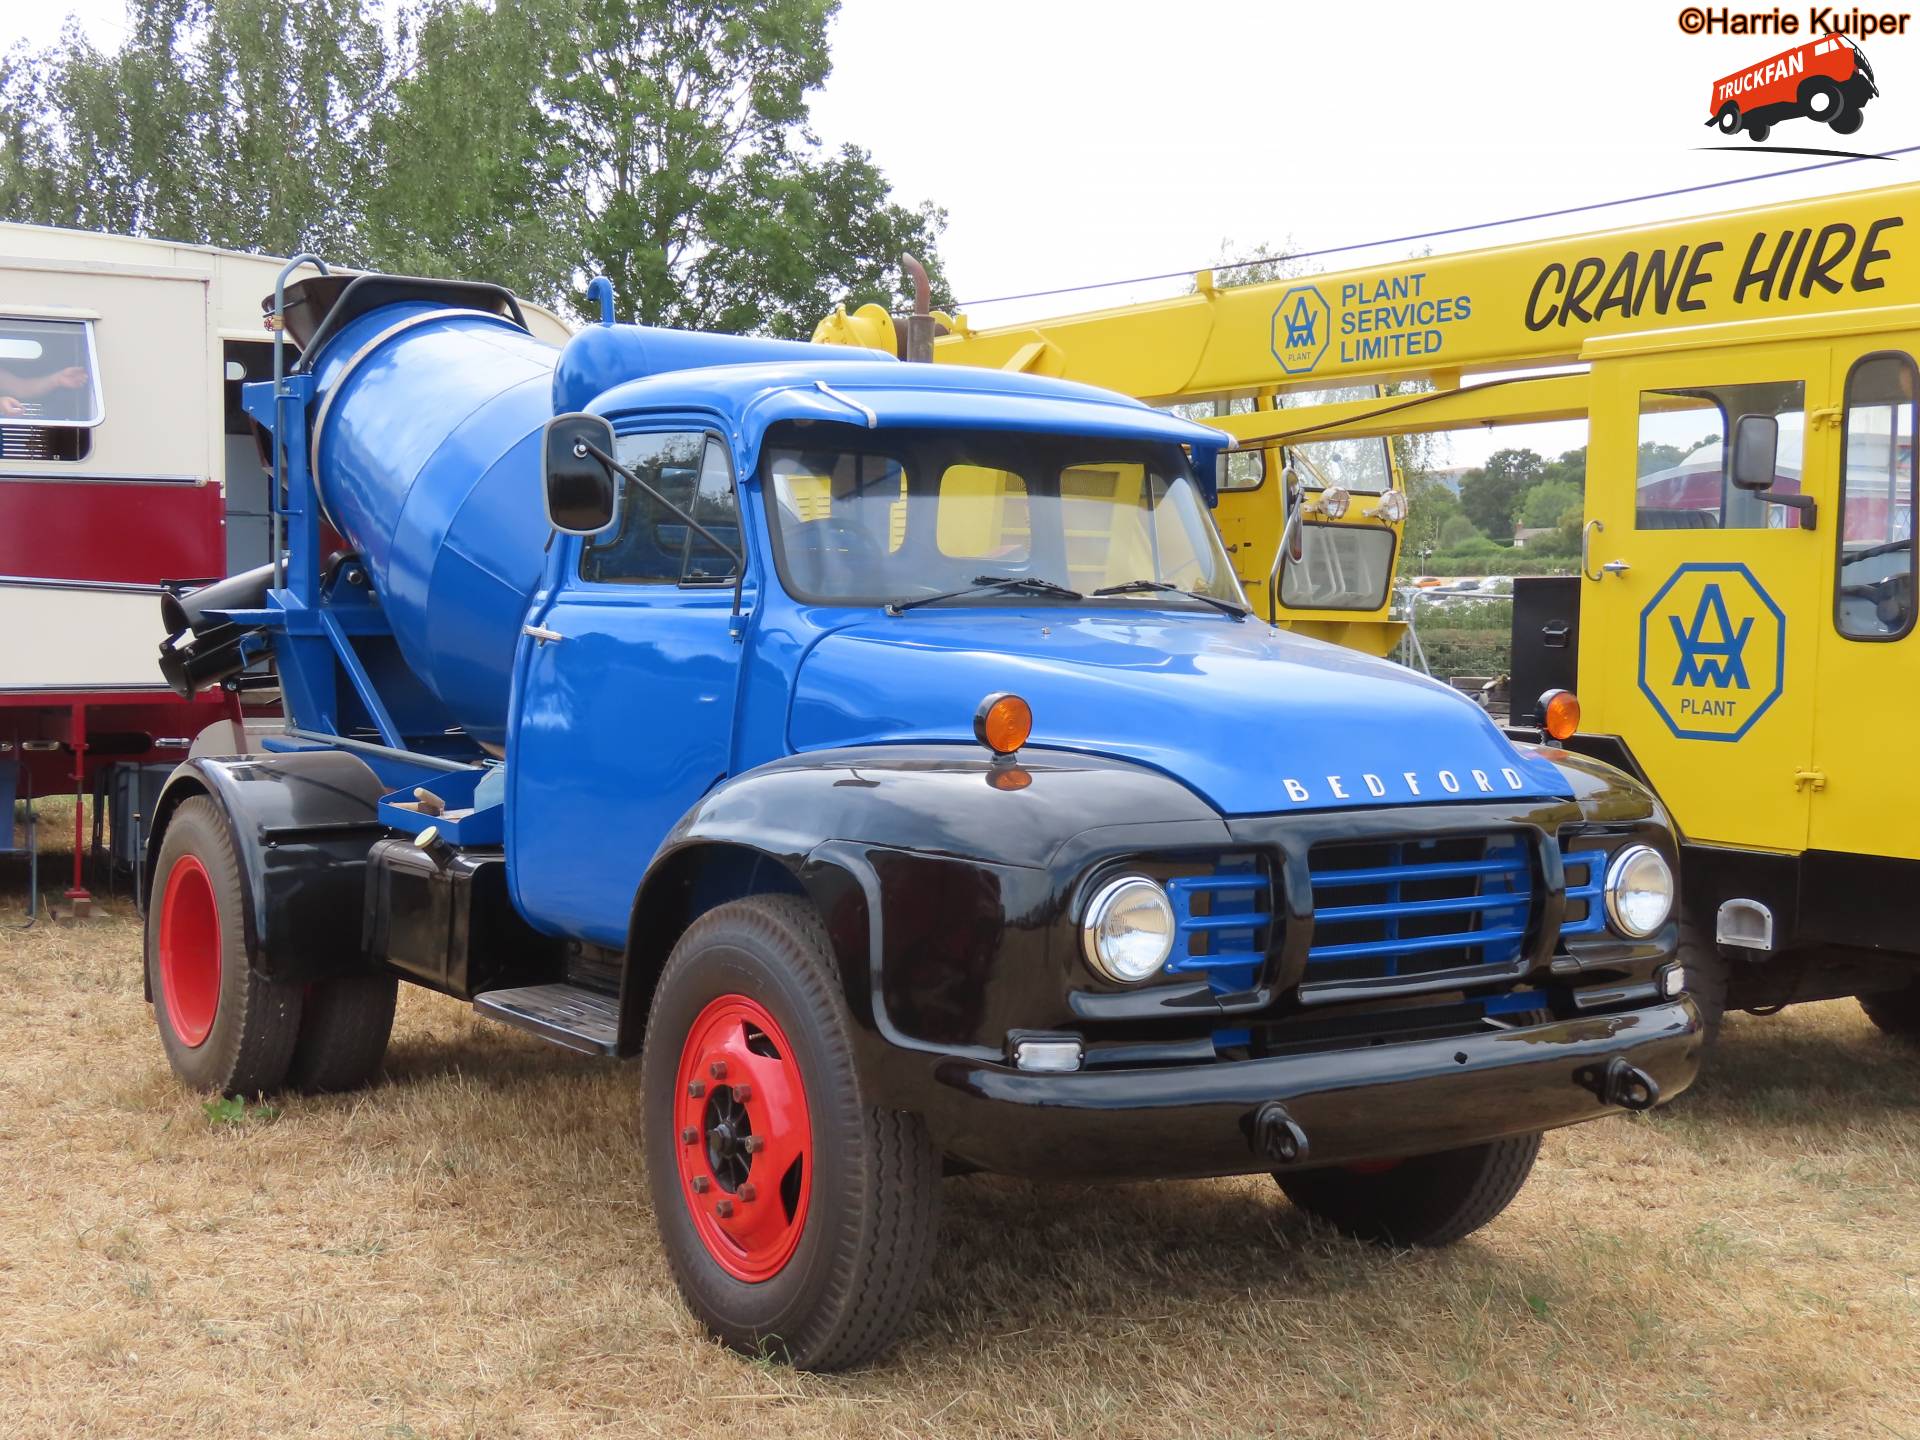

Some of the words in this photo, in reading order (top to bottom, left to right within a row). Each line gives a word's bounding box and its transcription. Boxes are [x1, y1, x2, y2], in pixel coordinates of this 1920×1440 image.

[1342, 273, 1426, 307] PLANT
[1525, 241, 1724, 332] CRANE
[1733, 216, 1904, 304] HIRE
[1340, 296, 1472, 335] SERVICES
[1287, 351, 1312, 362] PLANT
[1340, 329, 1443, 363] LIMITED
[1680, 698, 1736, 716] PLANT
[1282, 768, 1523, 802] BEDFORD
